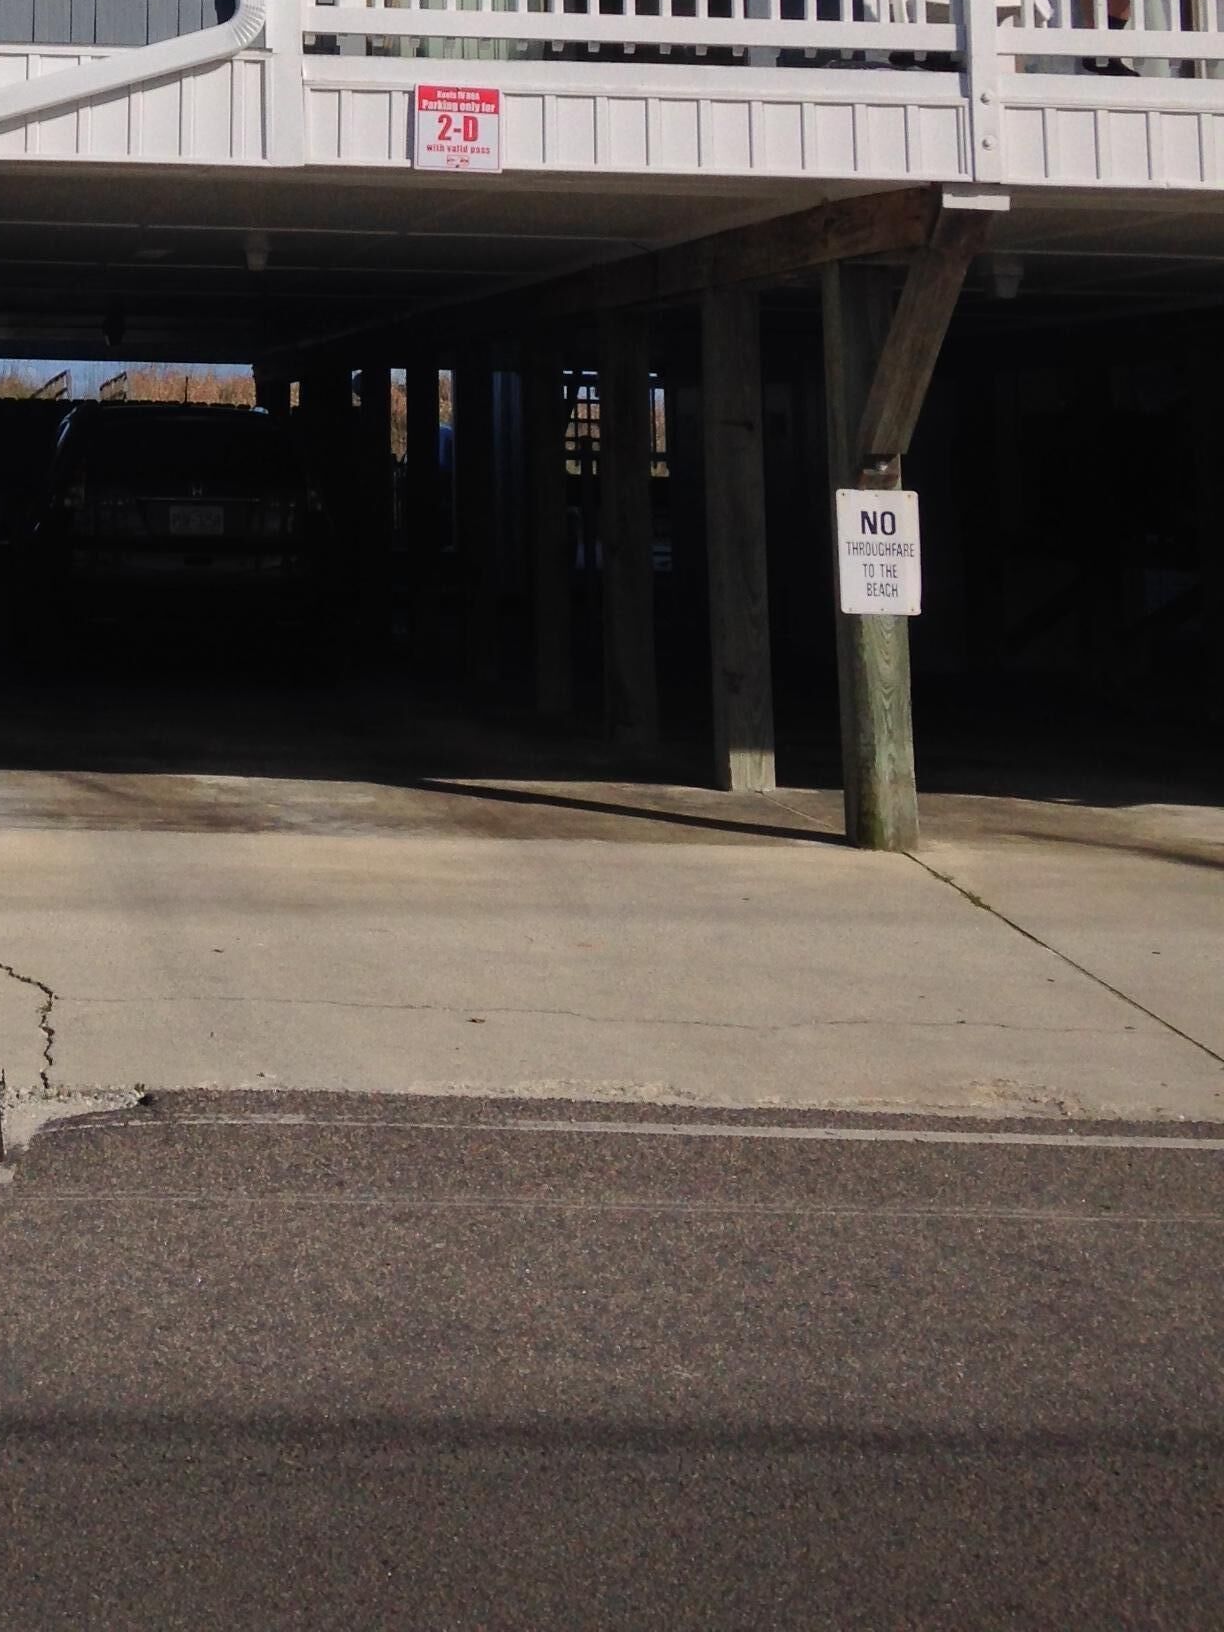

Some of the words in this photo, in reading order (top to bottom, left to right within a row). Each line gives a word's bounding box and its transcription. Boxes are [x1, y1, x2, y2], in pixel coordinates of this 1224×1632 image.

[421, 99, 458, 112] Parking
[459, 101, 481, 113] only
[482, 102, 496, 113] for
[437, 114, 479, 142] 2-D
[426, 144, 444, 152] with
[447, 145, 468, 153] valid
[470, 146, 490, 154] pass
[861, 510, 896, 535] NO
[846, 541, 915, 558] THROUGHFARE
[862, 563, 875, 578] TO
[880, 563, 898, 579] THE
[866, 583, 899, 598] BEACH
